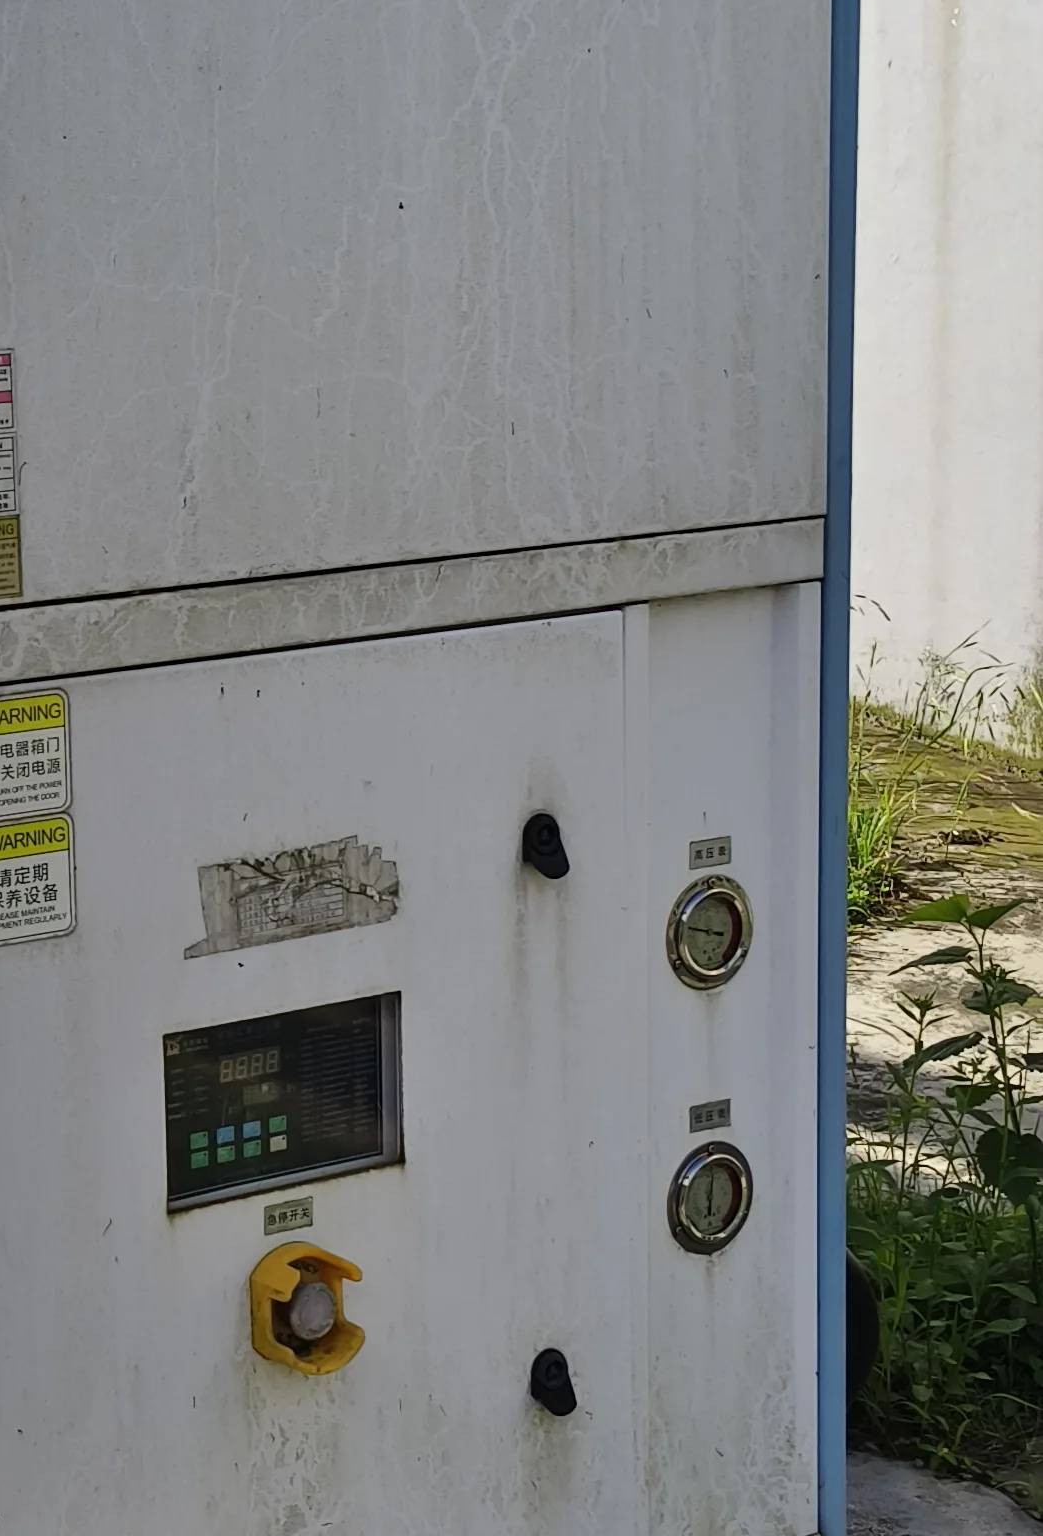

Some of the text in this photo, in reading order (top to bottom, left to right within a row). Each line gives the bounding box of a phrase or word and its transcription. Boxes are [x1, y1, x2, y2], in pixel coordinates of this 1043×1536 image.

[12, 785, 24, 793] OFF
[39, 780, 62, 789] POWER
[28, 794, 39, 802] THE
[21, 905, 55, 917] MAINTAIN
[24, 913, 67, 925] REGULARLY
